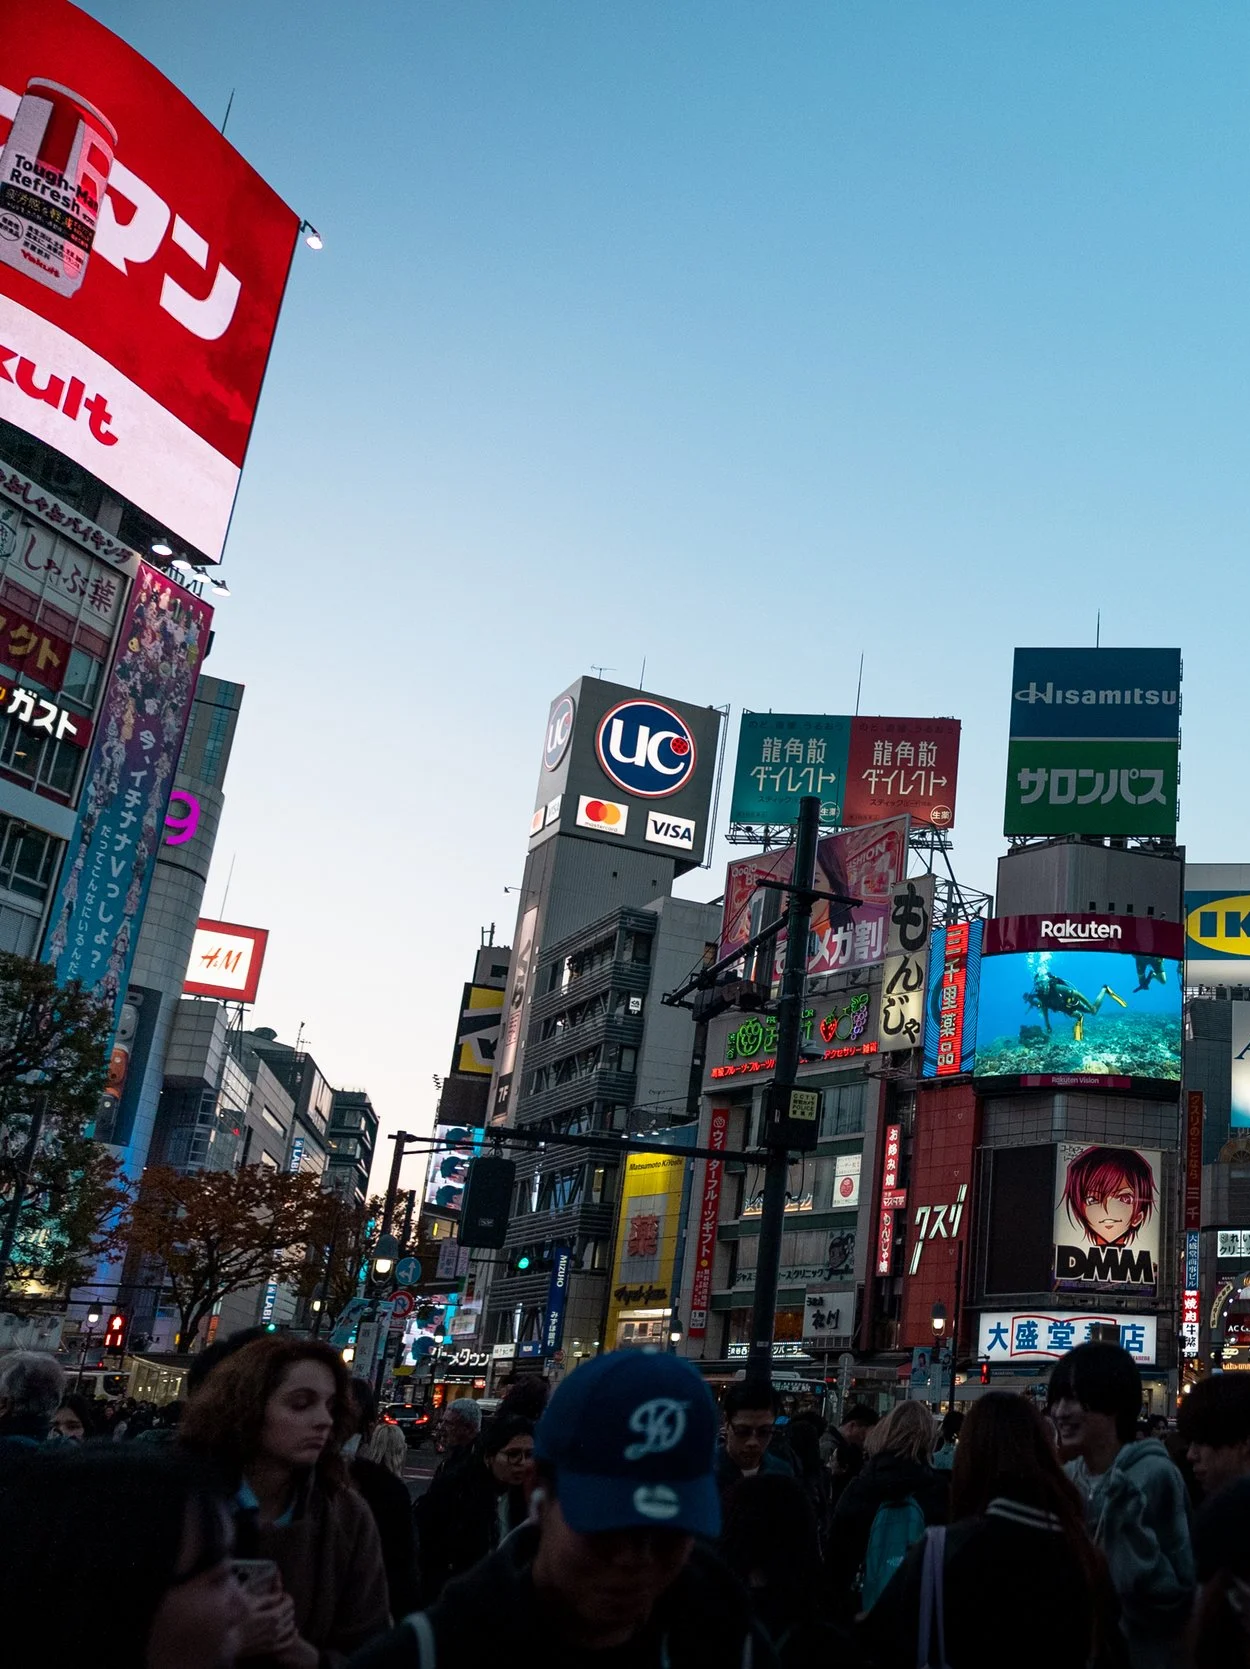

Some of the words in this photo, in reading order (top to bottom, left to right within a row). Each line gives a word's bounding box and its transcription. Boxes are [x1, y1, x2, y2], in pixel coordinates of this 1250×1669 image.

[10, 169, 81, 214] Refresh
[24, 534, 116, 613] しゃぶ葉
[0, 613, 61, 670] クト
[1014, 682, 1177, 705] Hisamitsu
[7, 687, 77, 740] ガスト
[609, 718, 685, 775] UC
[761, 736, 828, 764] 龍角散
[872, 739, 938, 768] 龍角散
[750, 766, 837, 793] ダイレクト
[861, 769, 948, 796] ダイレクト
[1017, 767, 1167, 805] サロンパス
[649, 819, 692, 842] VISA
[1041, 919, 1122, 939] Rakuten
[201, 947, 242, 974] H&M
[883, 882, 927, 1044] もんじゃ
[701, 1129, 726, 1257] ウィターフルーツギフト
[556, 1254, 568, 1288] MIZUHO
[1055, 1244, 1156, 1285] DMM
